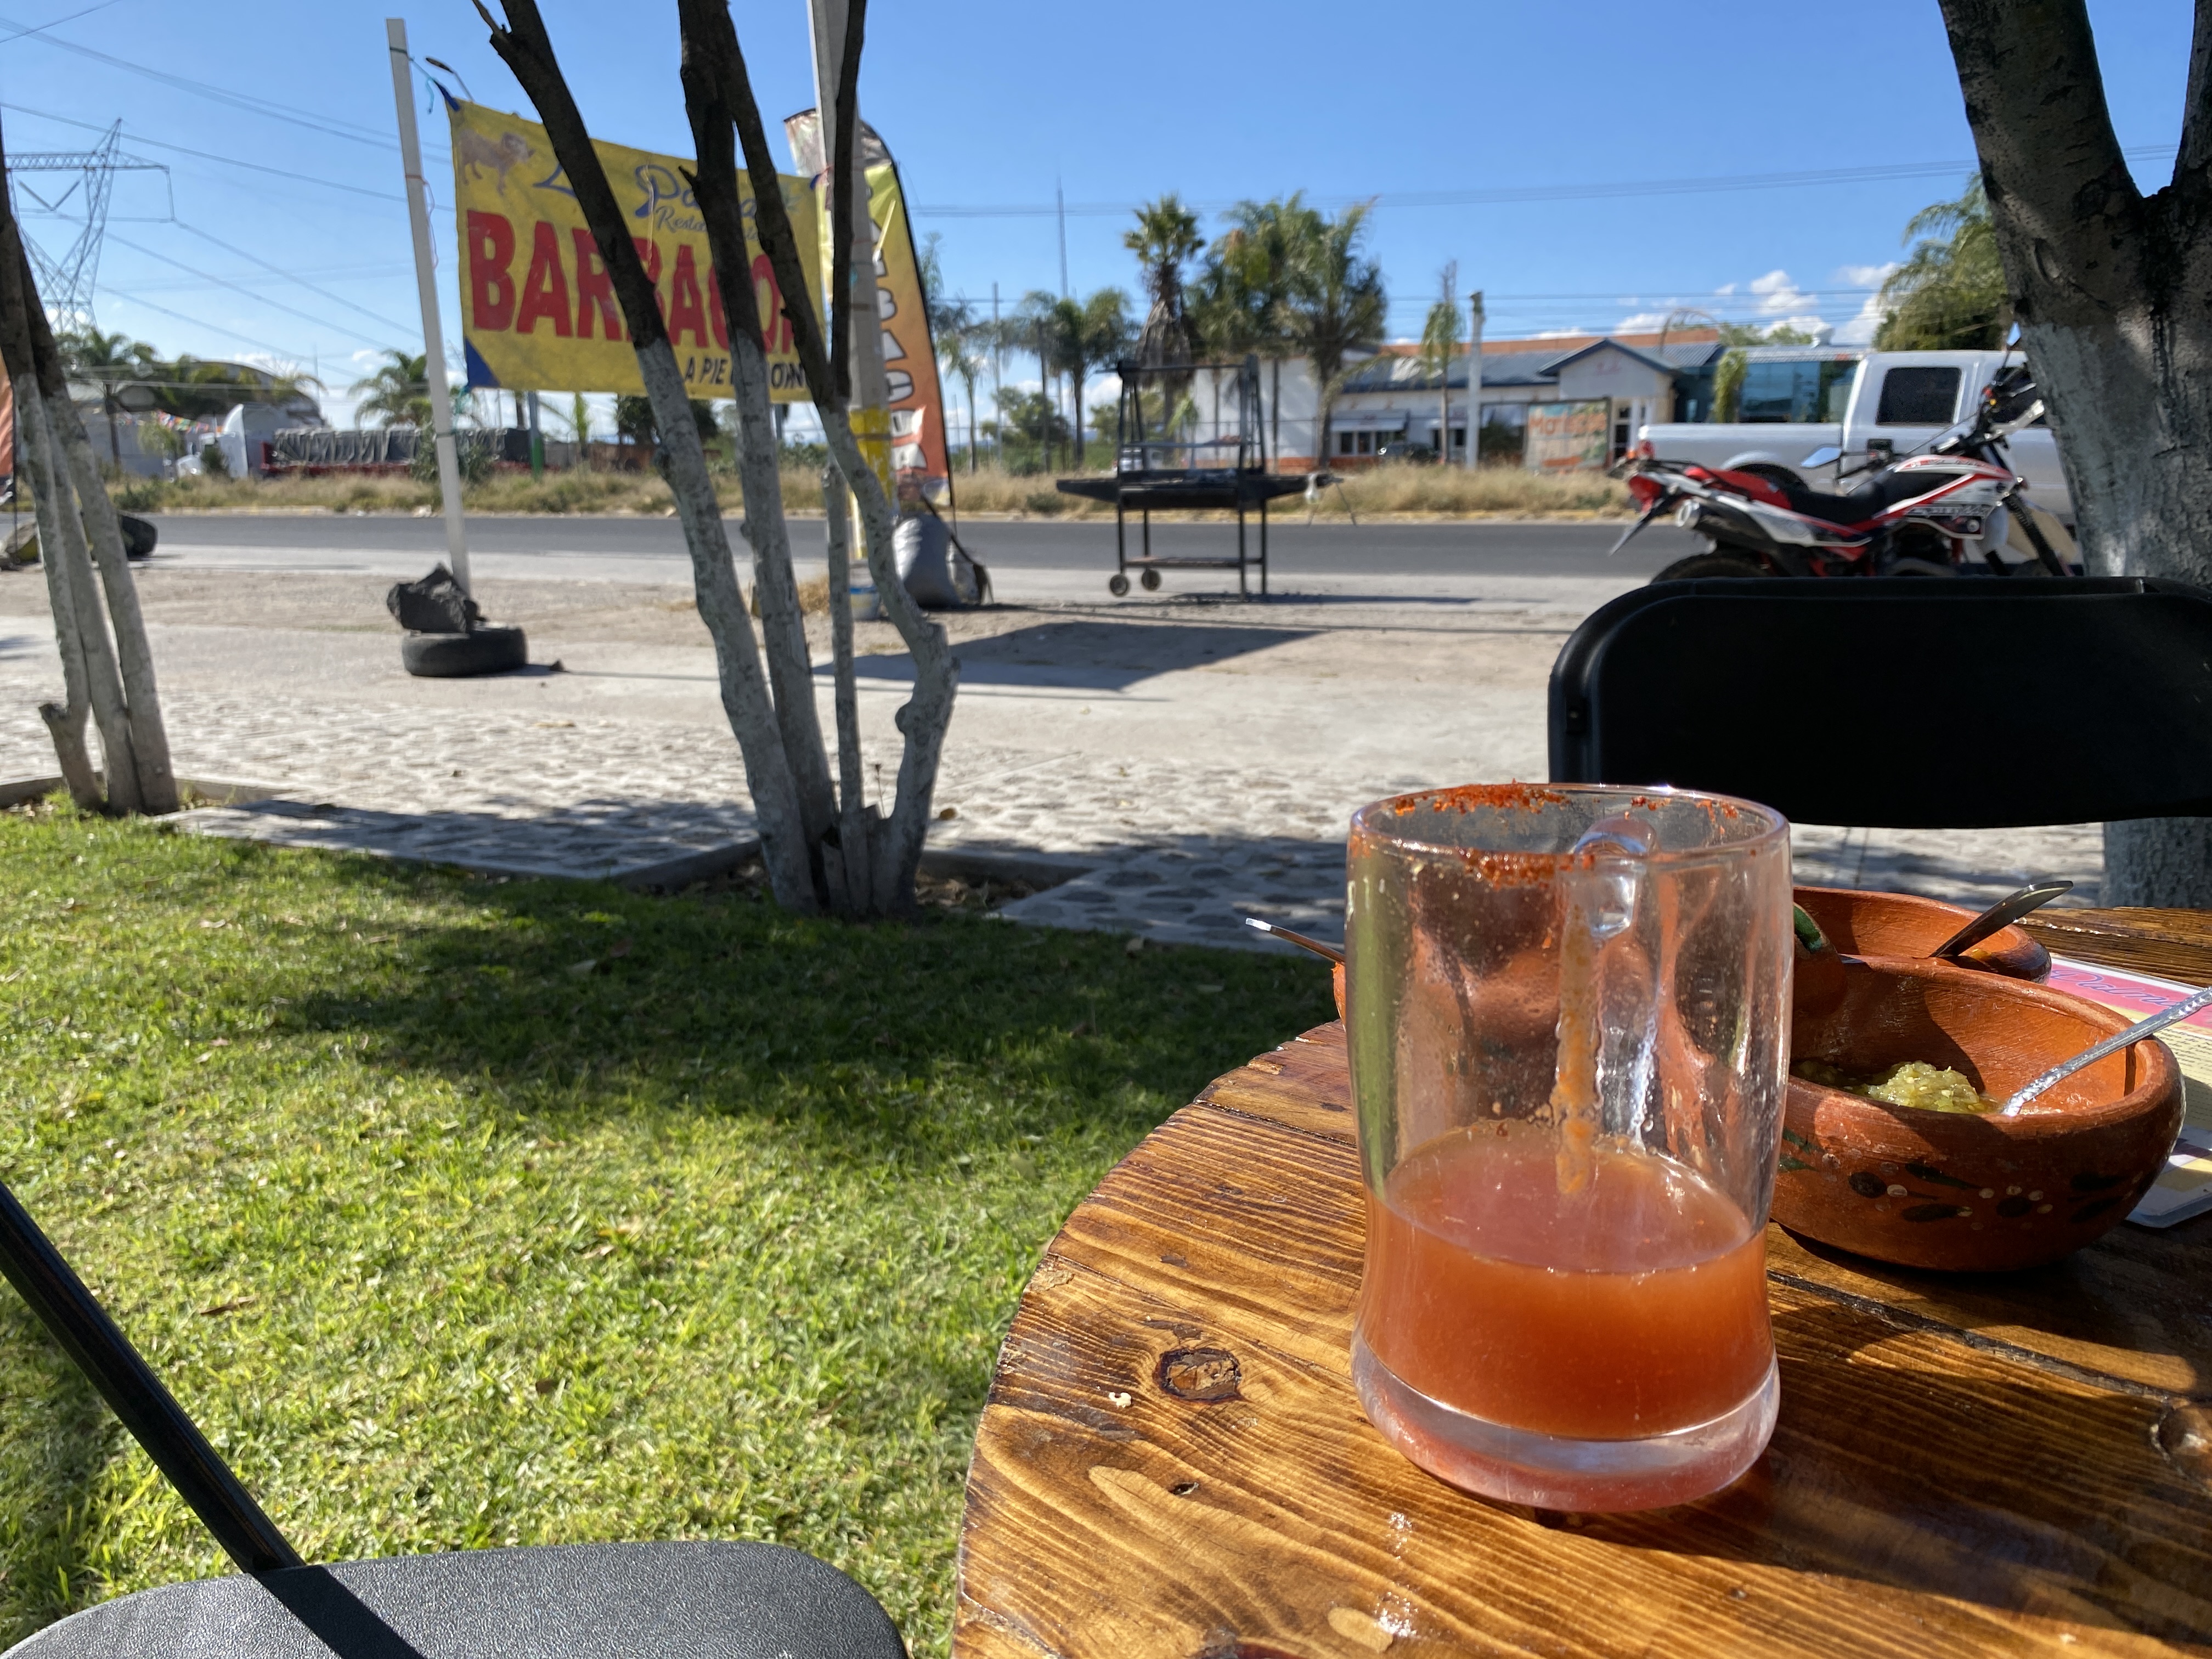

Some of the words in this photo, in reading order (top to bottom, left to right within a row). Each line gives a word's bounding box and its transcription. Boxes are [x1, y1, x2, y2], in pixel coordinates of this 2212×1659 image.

[467, 208, 795, 356] BARAO
[686, 357, 695, 382] A
[699, 358, 729, 385] PIE
